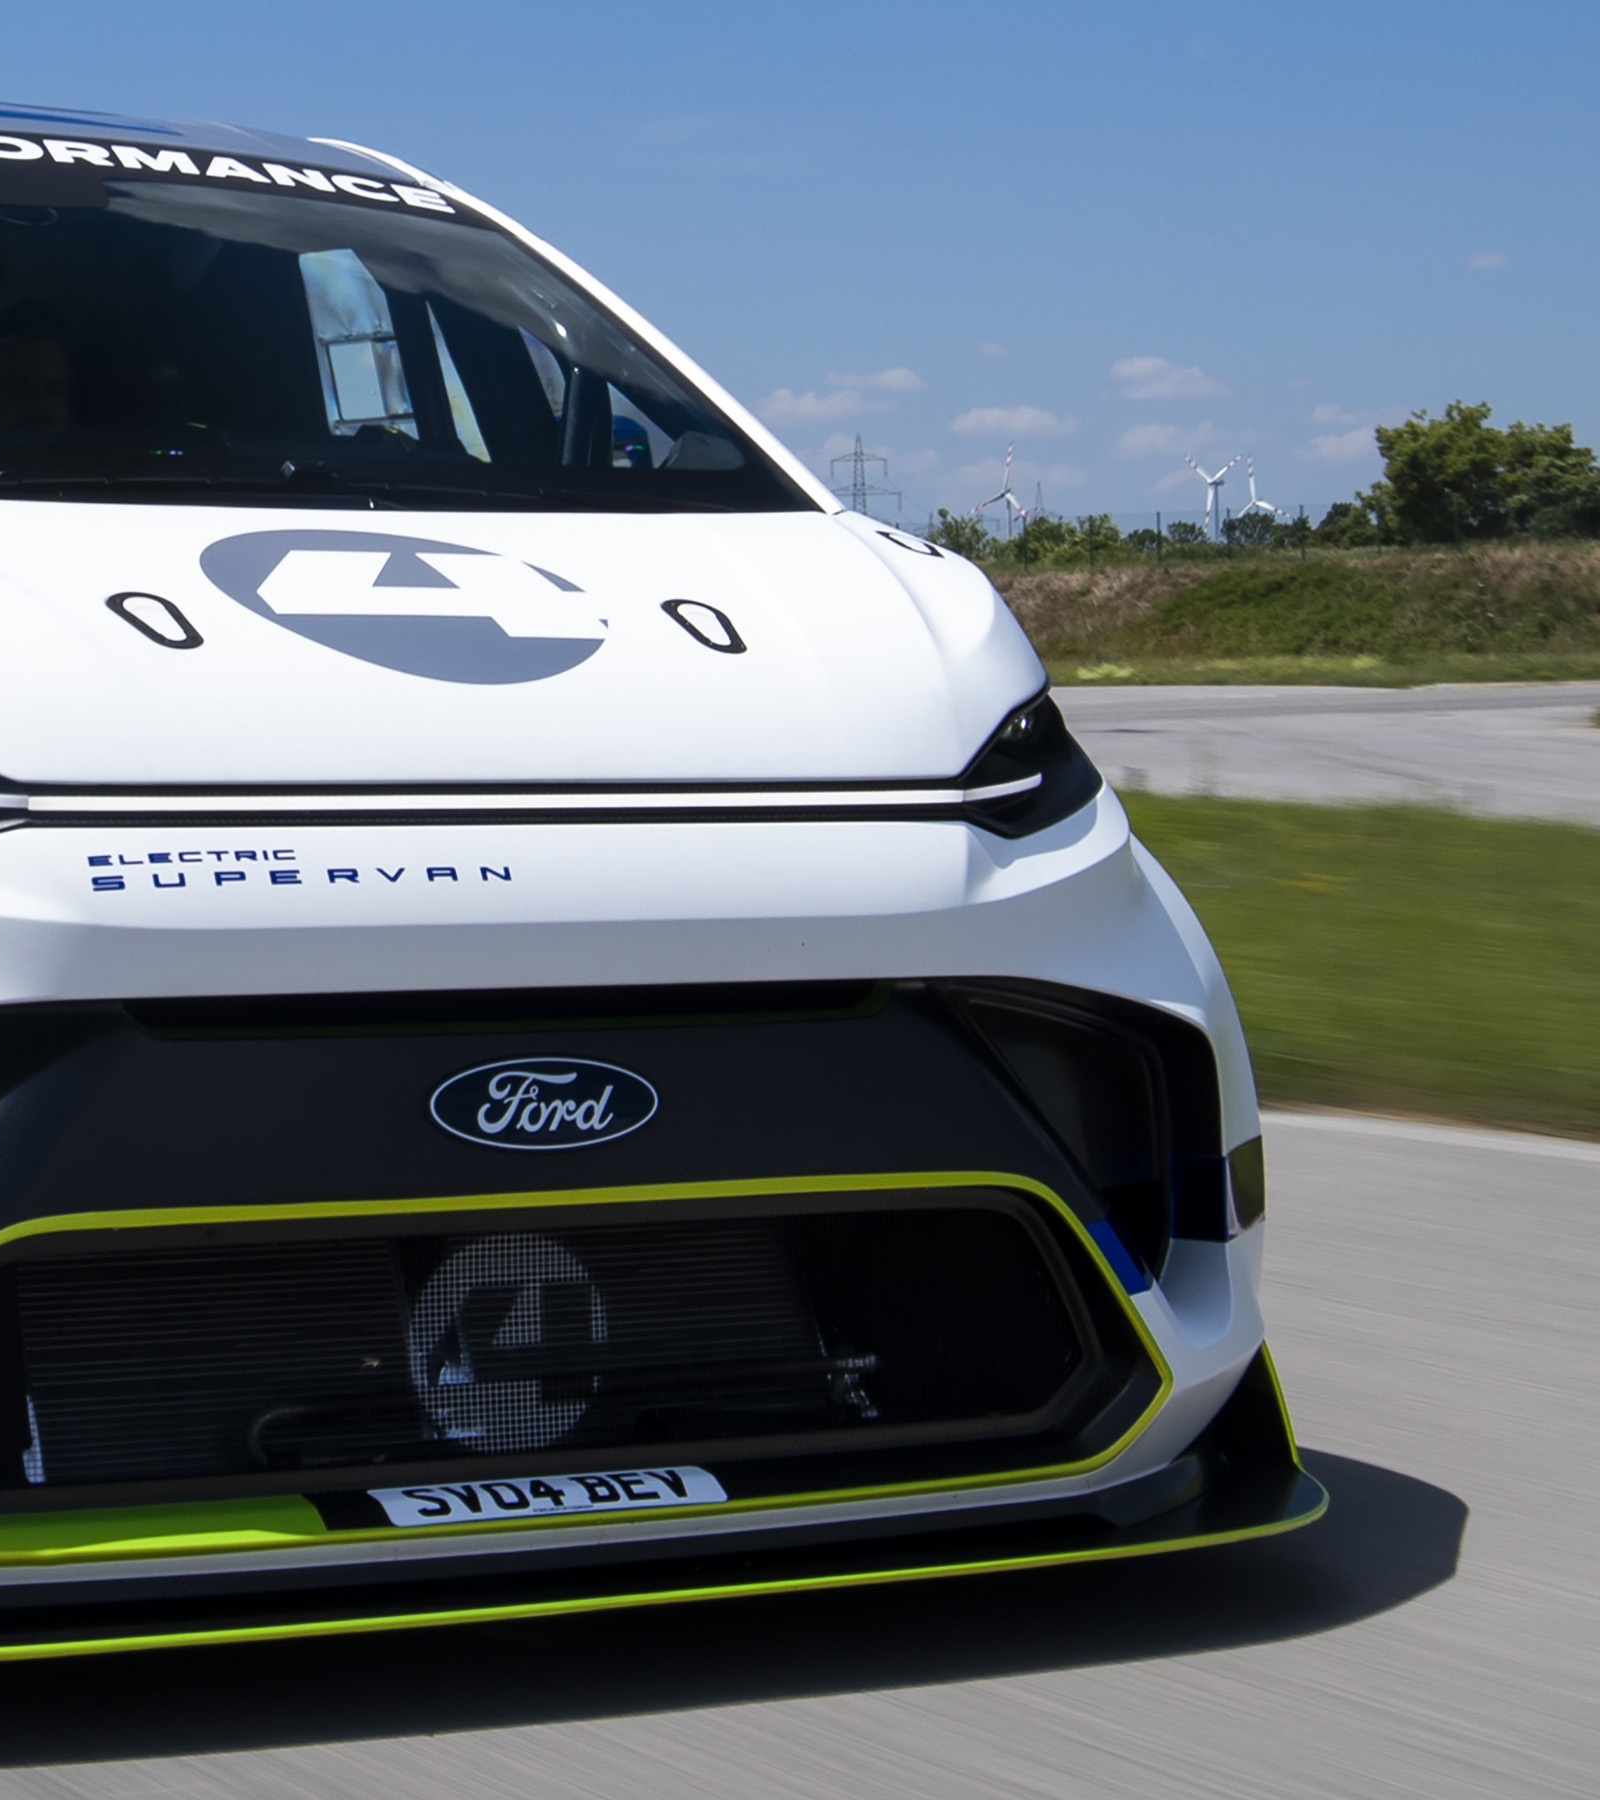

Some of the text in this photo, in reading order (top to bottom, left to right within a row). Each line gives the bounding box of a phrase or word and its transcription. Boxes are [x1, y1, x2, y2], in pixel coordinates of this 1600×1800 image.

[86, 848, 297, 867] ELECTRIC
[90, 865, 513, 892] SUPERVAN
[476, 1070, 614, 1135] Ford
[401, 1469, 690, 1518] SV04 BEV
